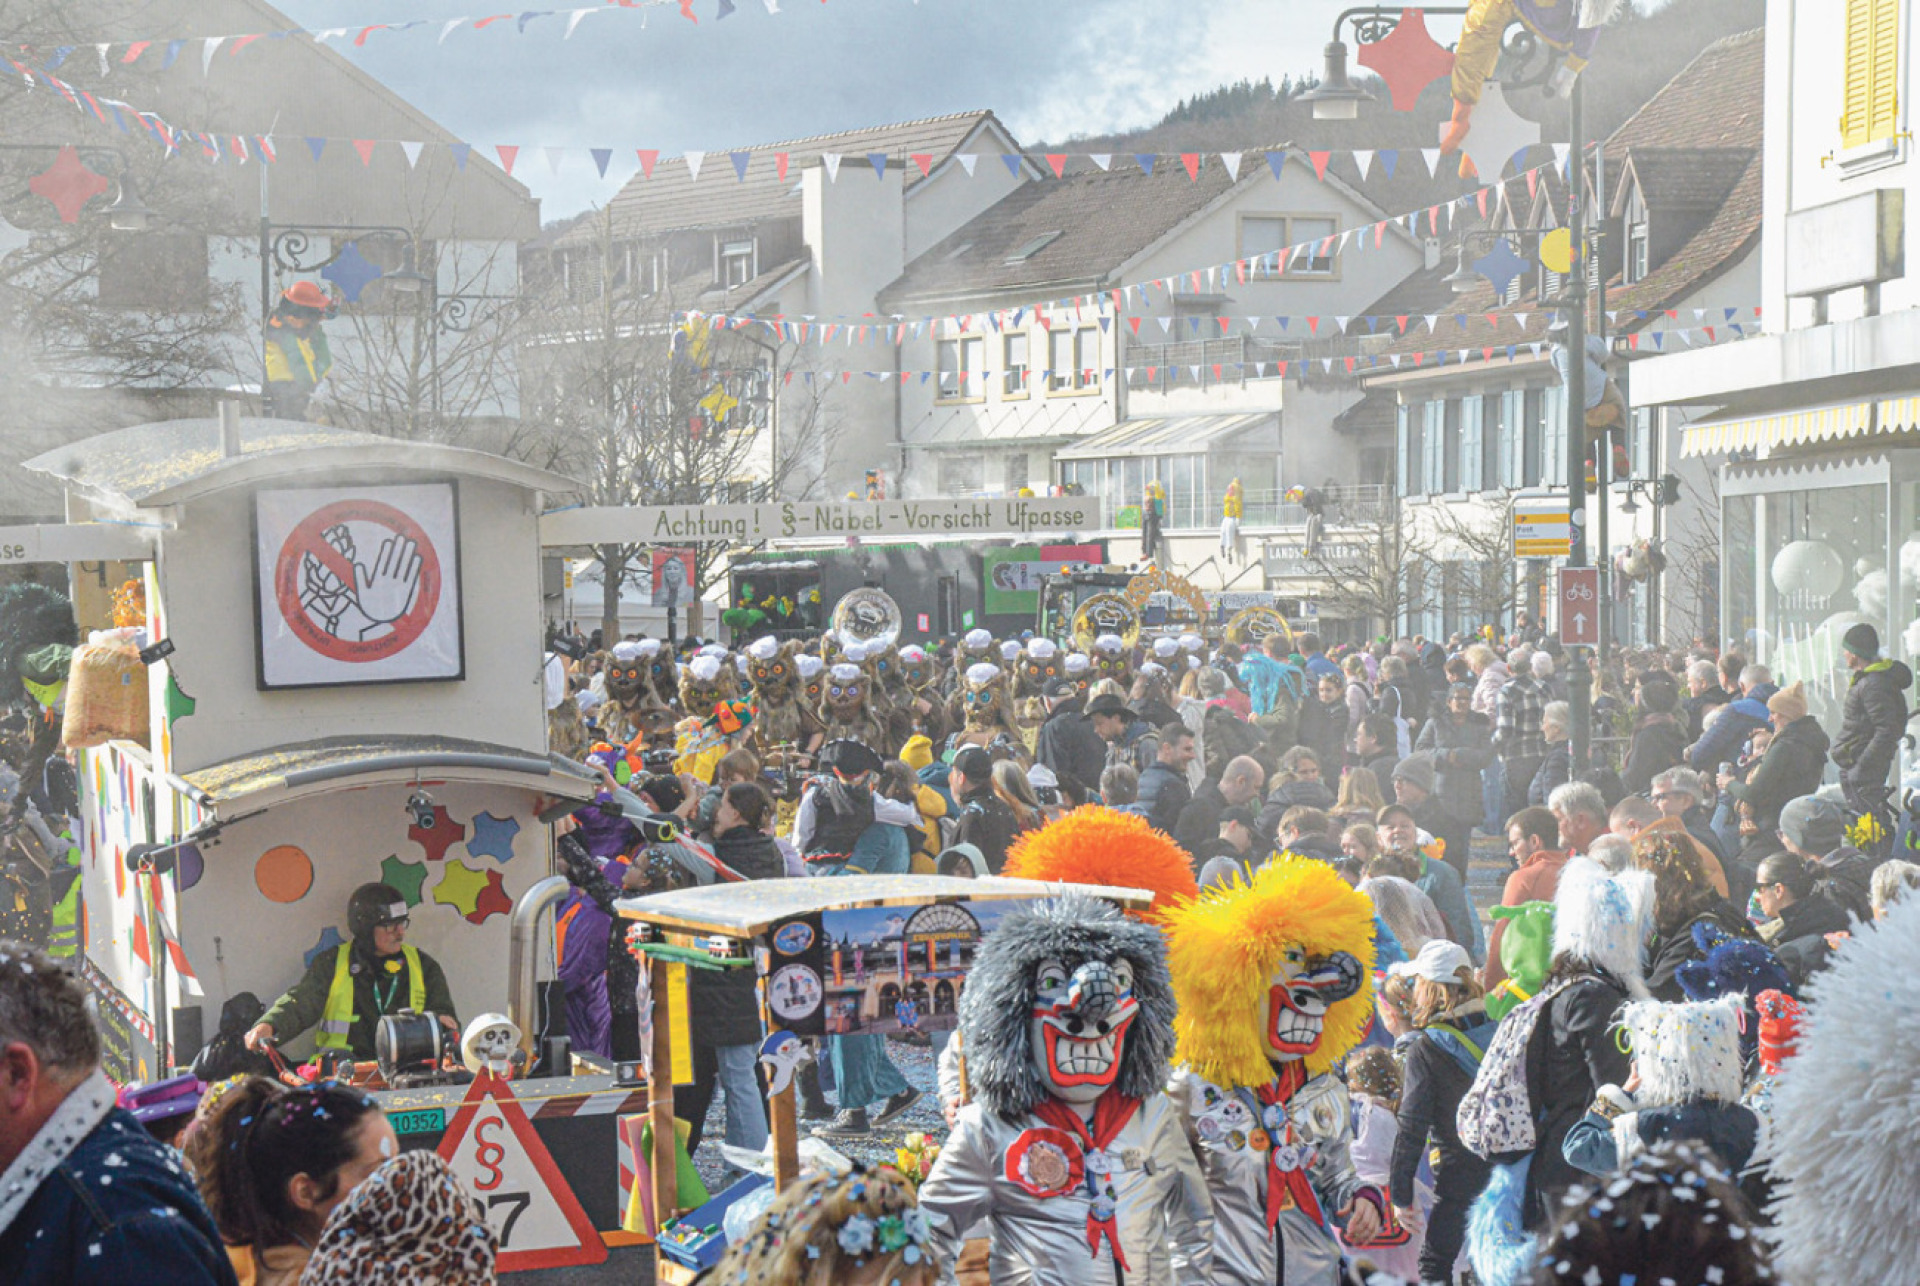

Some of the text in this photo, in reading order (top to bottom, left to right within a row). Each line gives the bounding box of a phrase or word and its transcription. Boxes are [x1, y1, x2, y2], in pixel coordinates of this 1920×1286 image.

[1006, 502, 1084, 532] Ufpasse
[0, 544, 25, 559] se
[393, 1112, 438, 1132] 10352
